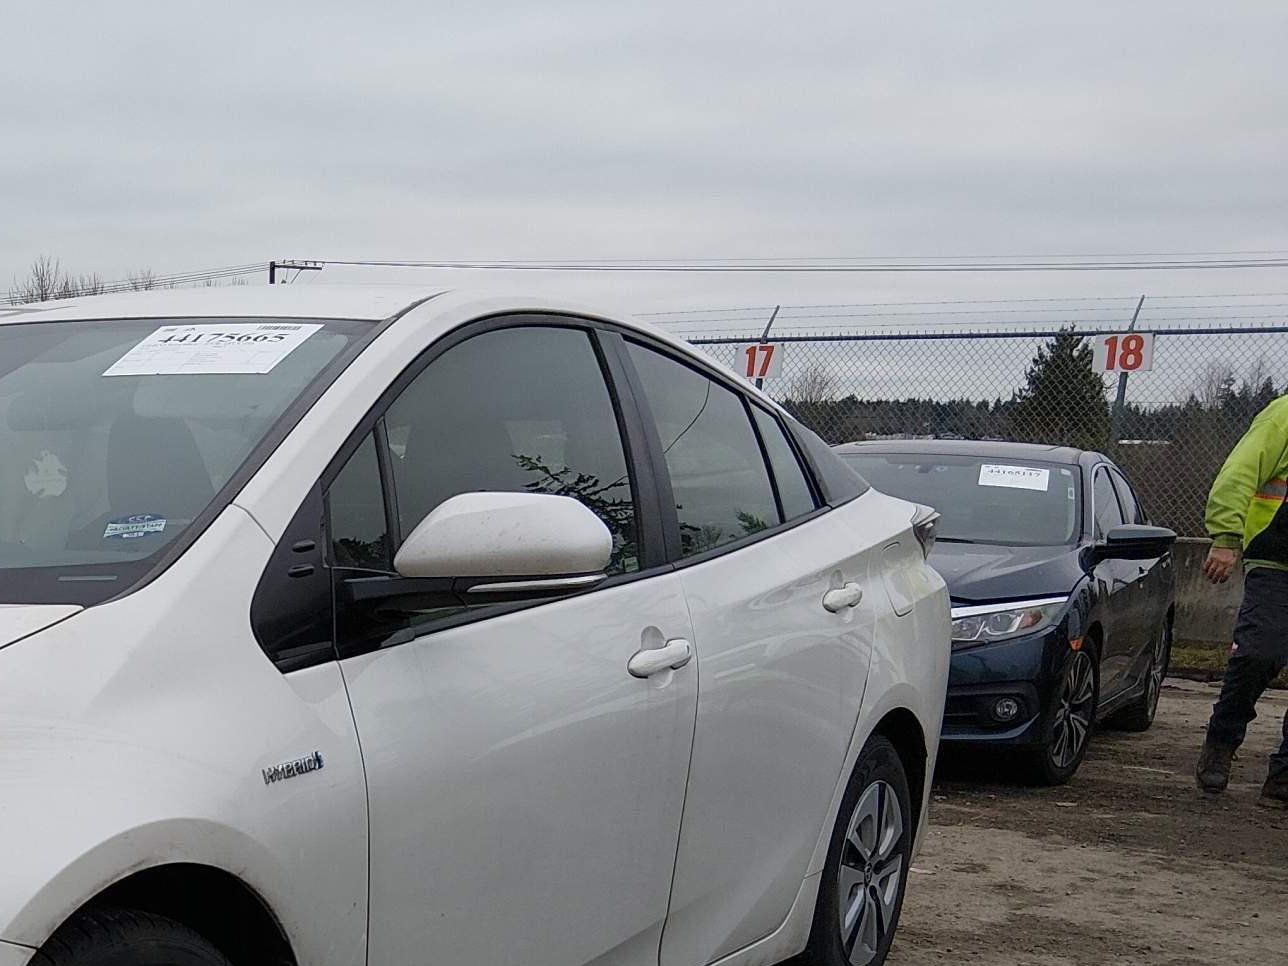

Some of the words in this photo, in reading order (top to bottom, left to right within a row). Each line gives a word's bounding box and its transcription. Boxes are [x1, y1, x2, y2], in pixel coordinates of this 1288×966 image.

[158, 333, 289, 343] 44175665
[1104, 335, 1144, 370] 18
[746, 346, 775, 377] 17
[262, 756, 318, 785] HYBRID
